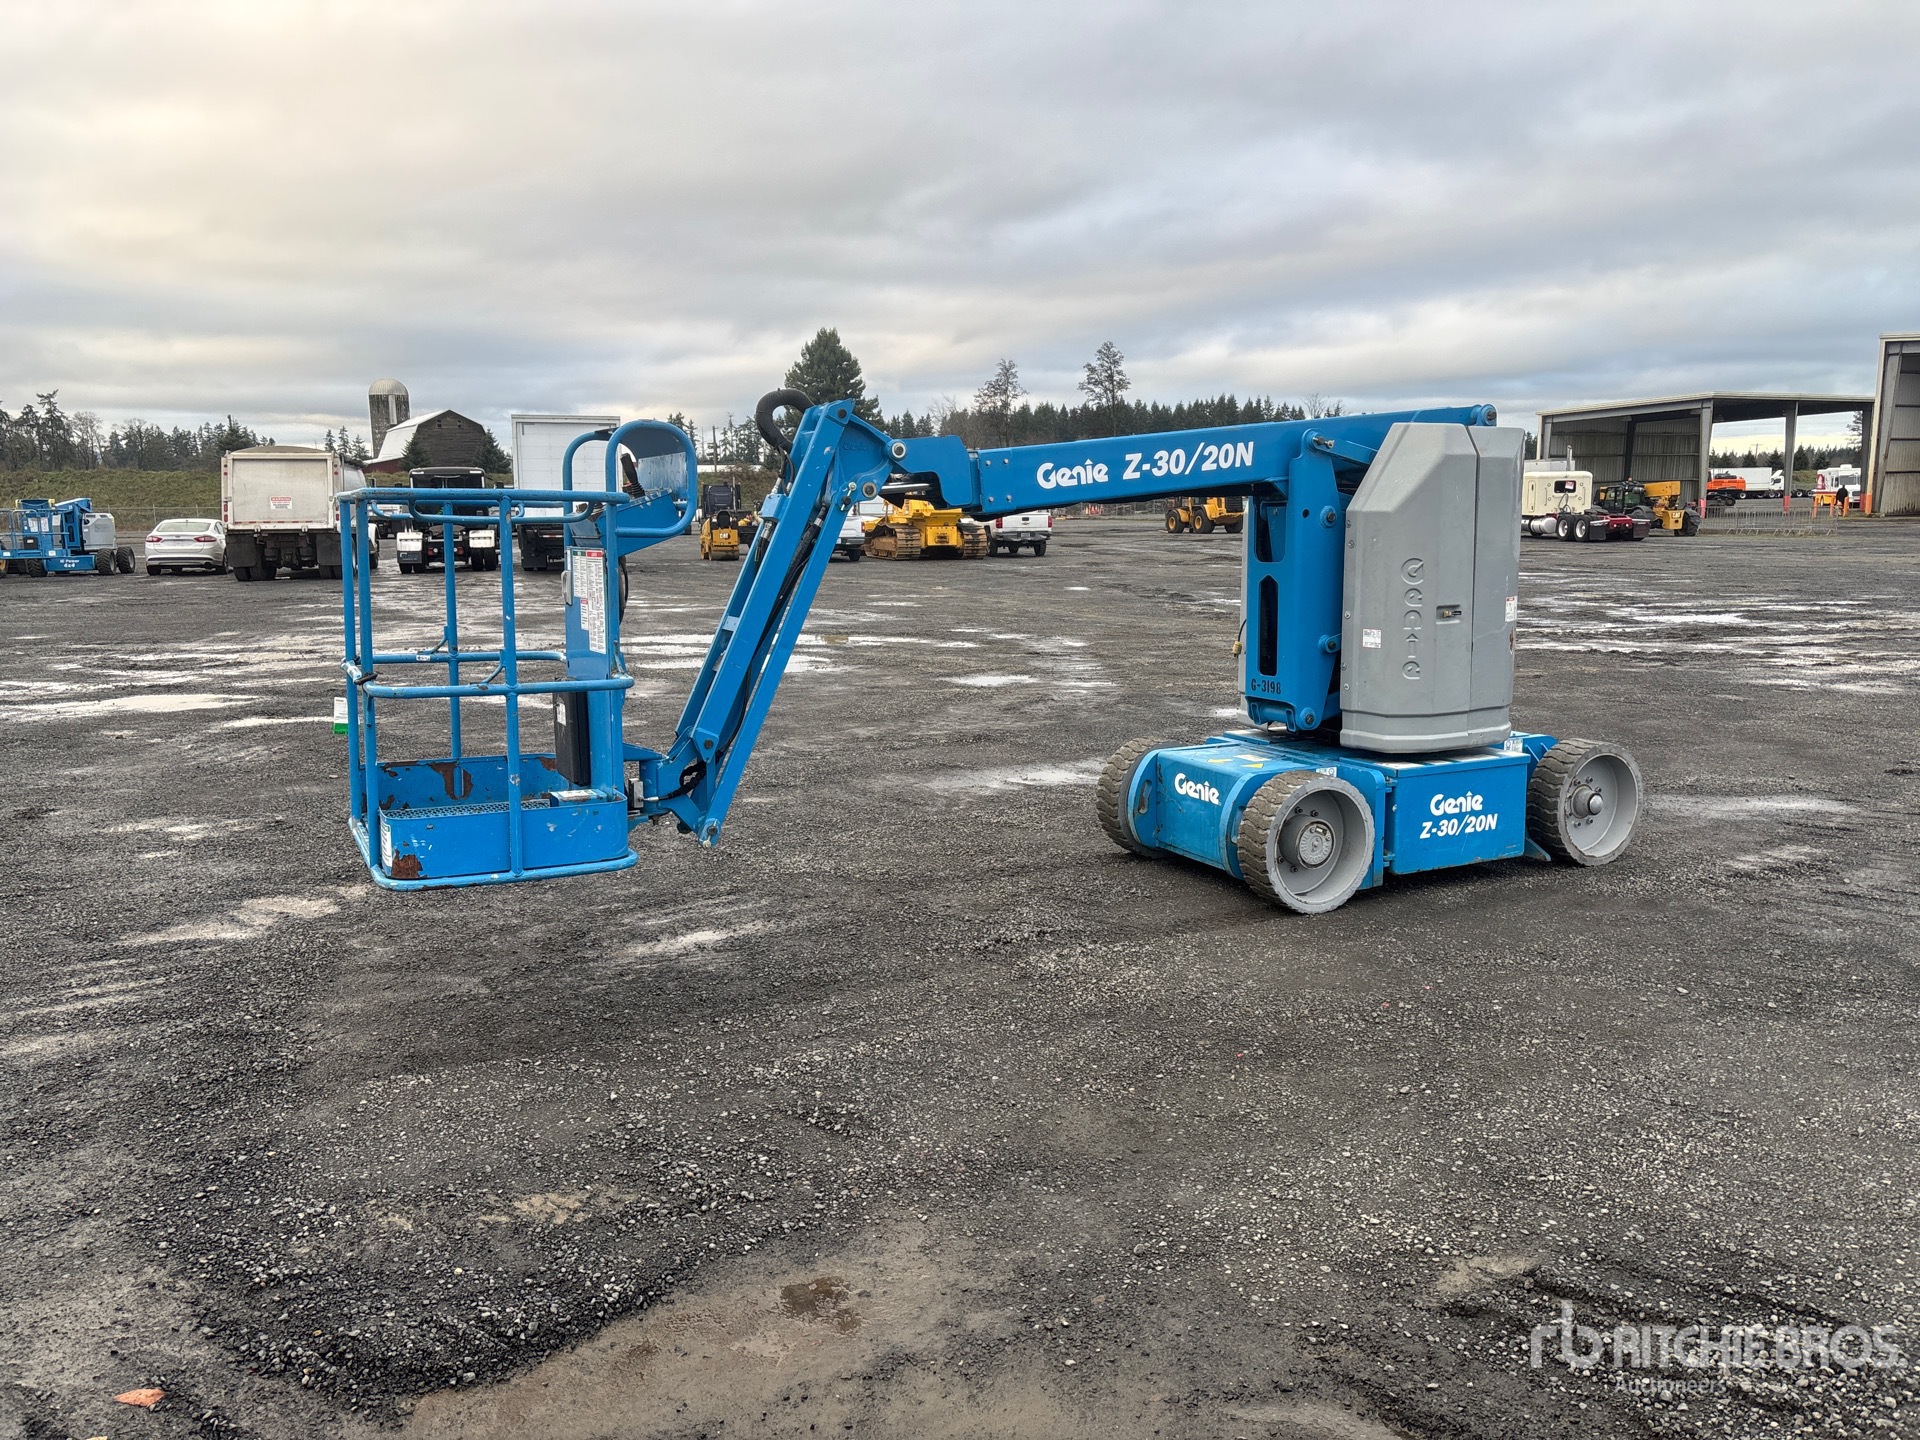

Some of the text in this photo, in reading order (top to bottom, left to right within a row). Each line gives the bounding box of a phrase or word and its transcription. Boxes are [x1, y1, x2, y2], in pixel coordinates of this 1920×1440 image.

[1036, 441, 1254, 490] Genie Z-30/20N
[1400, 557, 1424, 680] Genie
[1251, 678, 1281, 695] G-3198
[1174, 772, 1220, 806] Genie
[1430, 790, 1484, 817] Genie
[1419, 813, 1498, 839] Z-30/20N
